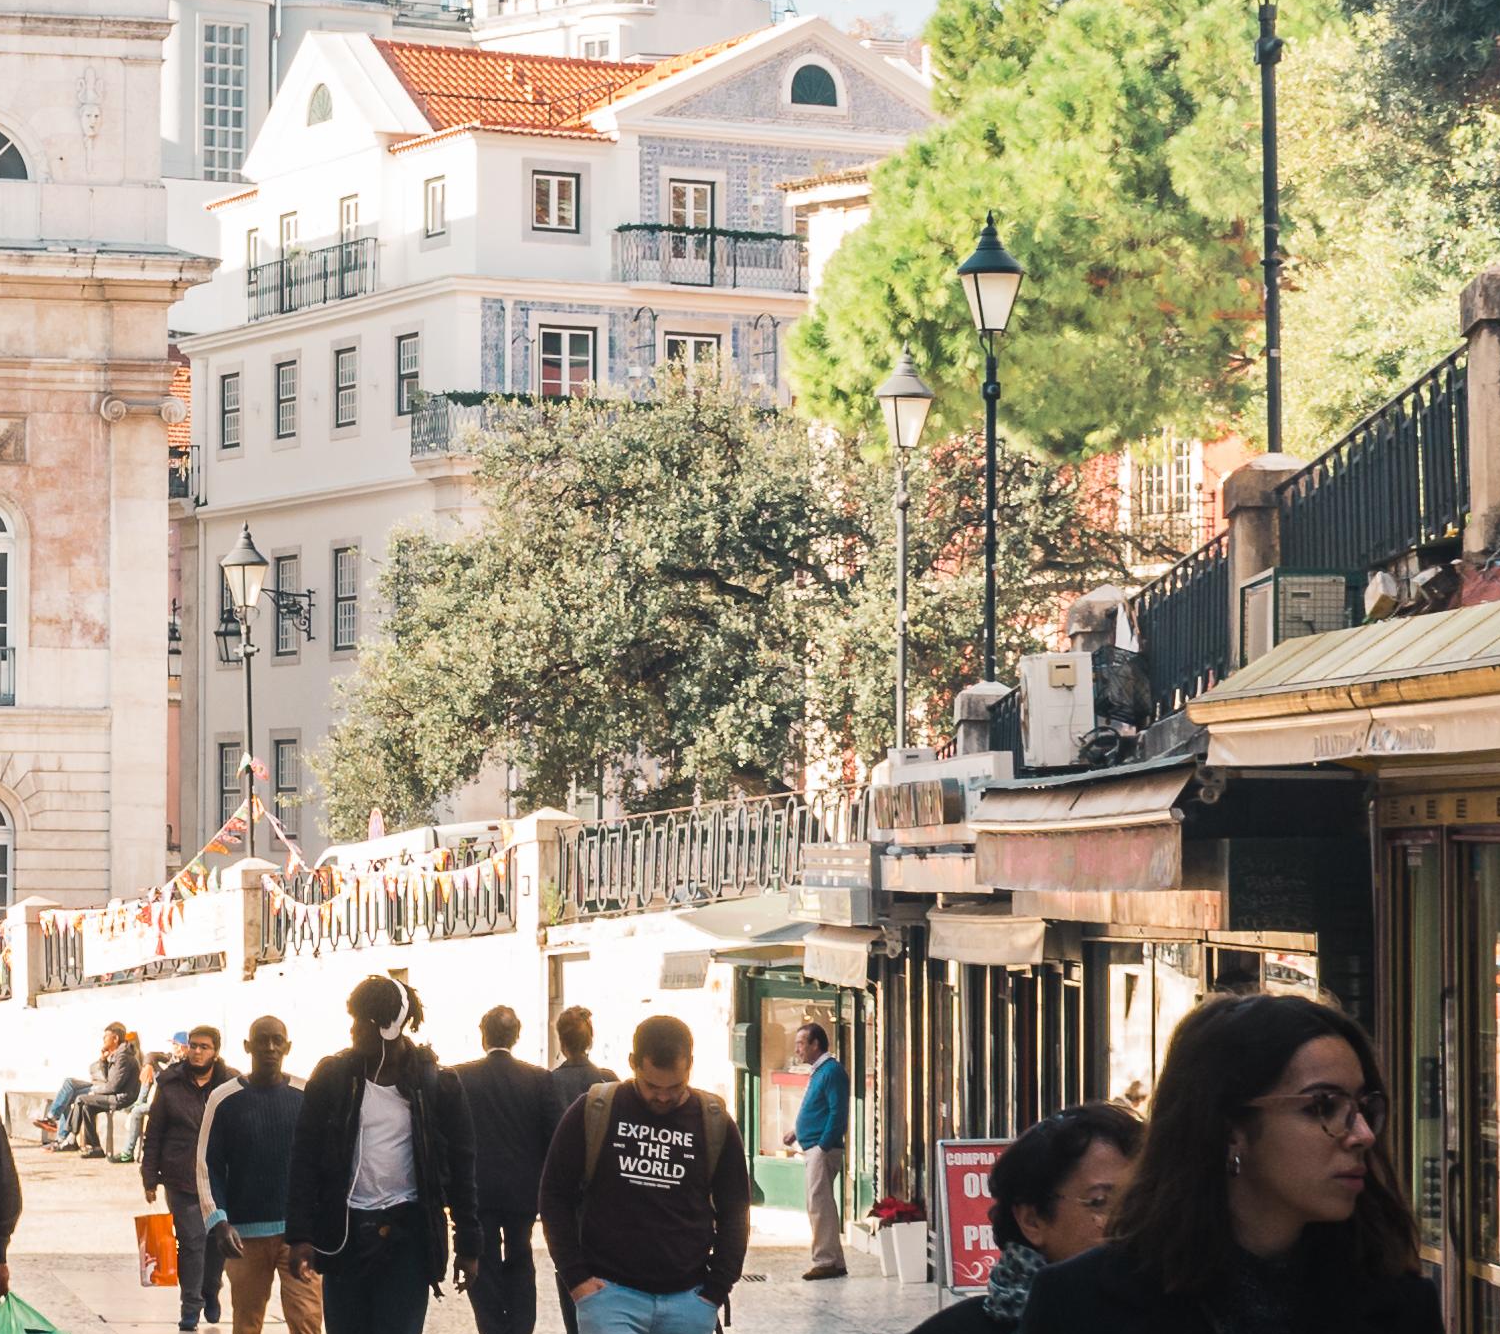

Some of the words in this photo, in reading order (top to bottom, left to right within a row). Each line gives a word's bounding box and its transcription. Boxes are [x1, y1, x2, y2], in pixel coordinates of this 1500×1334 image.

[617, 1121, 694, 1147] EXPLORE
[637, 1141, 671, 1160] THE
[946, 1152, 996, 1166] COMPRA
[619, 1155, 686, 1179] WORLD
